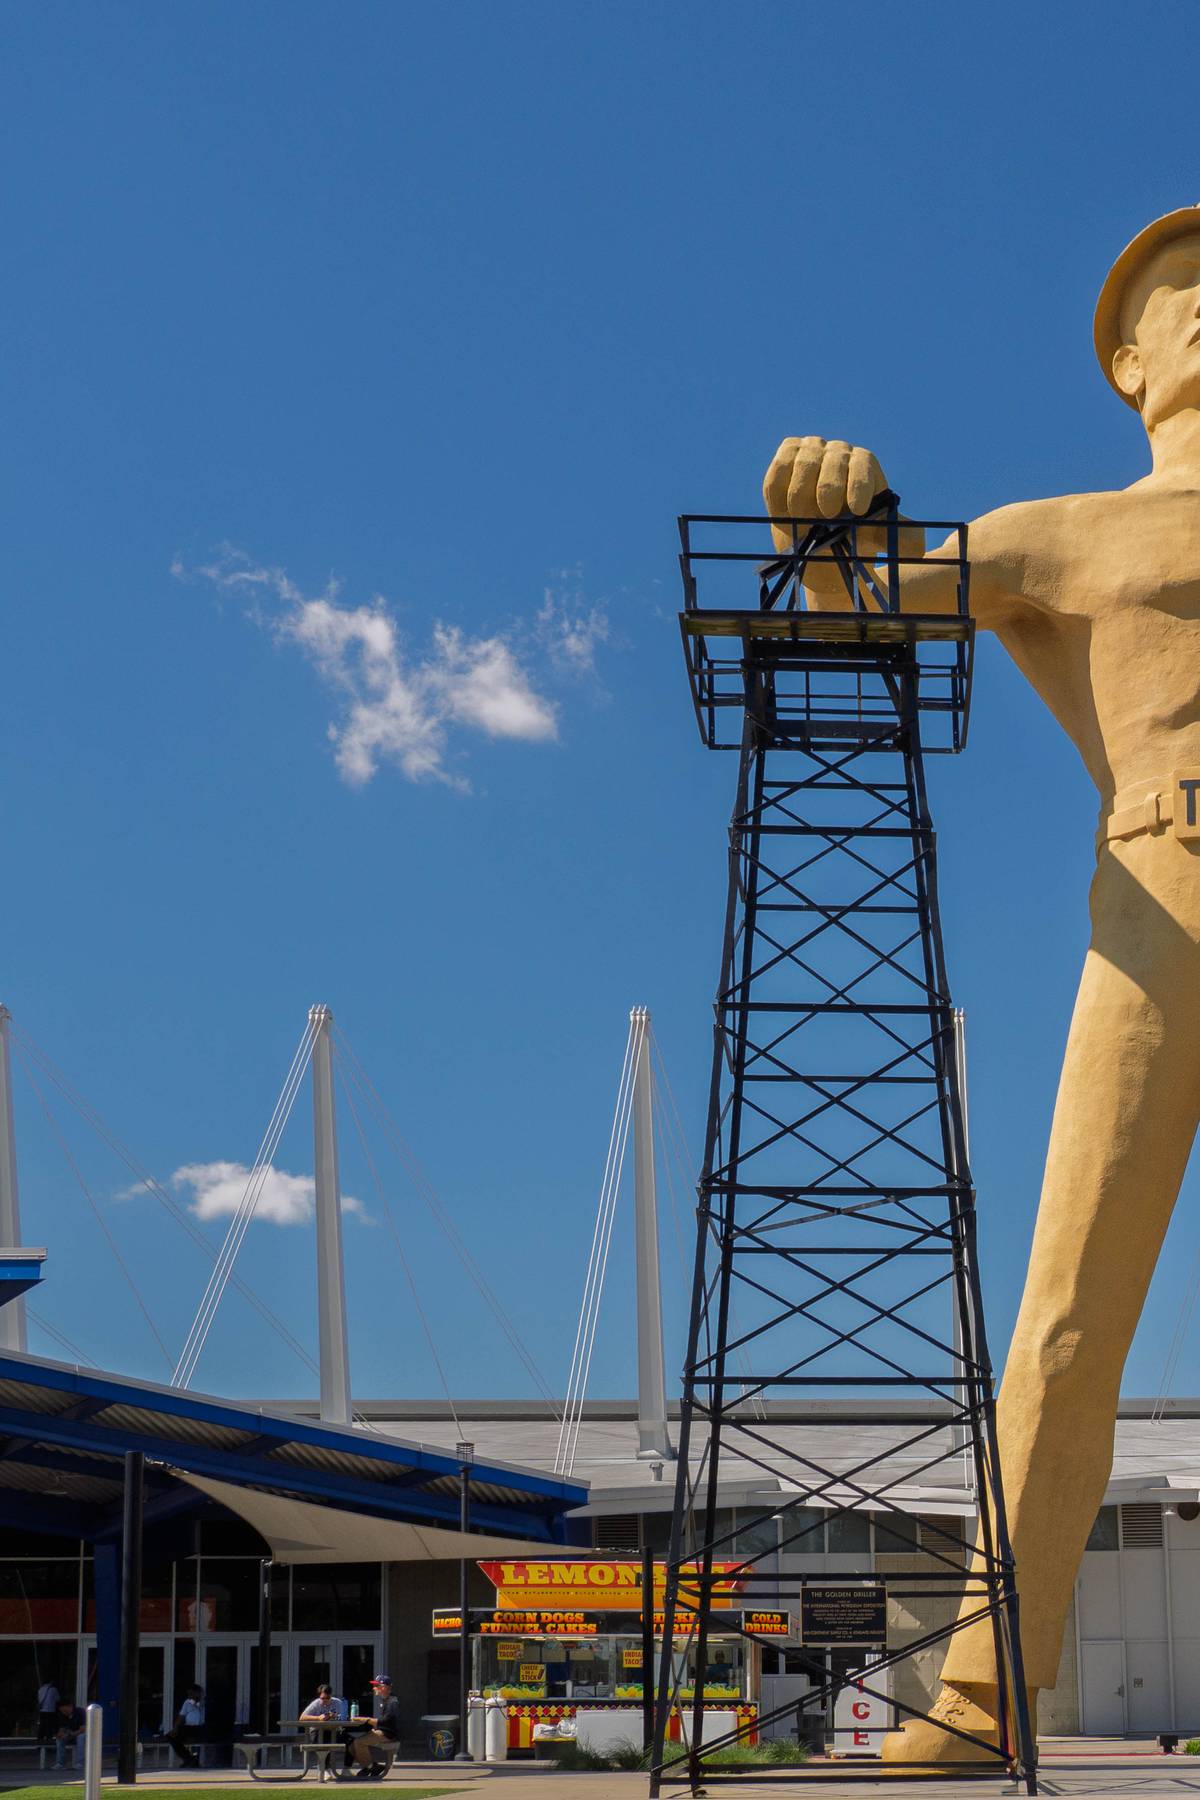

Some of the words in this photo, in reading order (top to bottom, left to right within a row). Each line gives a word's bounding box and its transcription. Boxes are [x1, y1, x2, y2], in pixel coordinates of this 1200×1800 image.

[493, 1612, 538, 1623] CORN
[540, 1612, 585, 1623] DOGS
[751, 1613, 782, 1623] COLD
[480, 1623, 542, 1633] FUNNEL
[545, 1623, 597, 1633] CAKES
[745, 1623, 788, 1633] DRINKS
